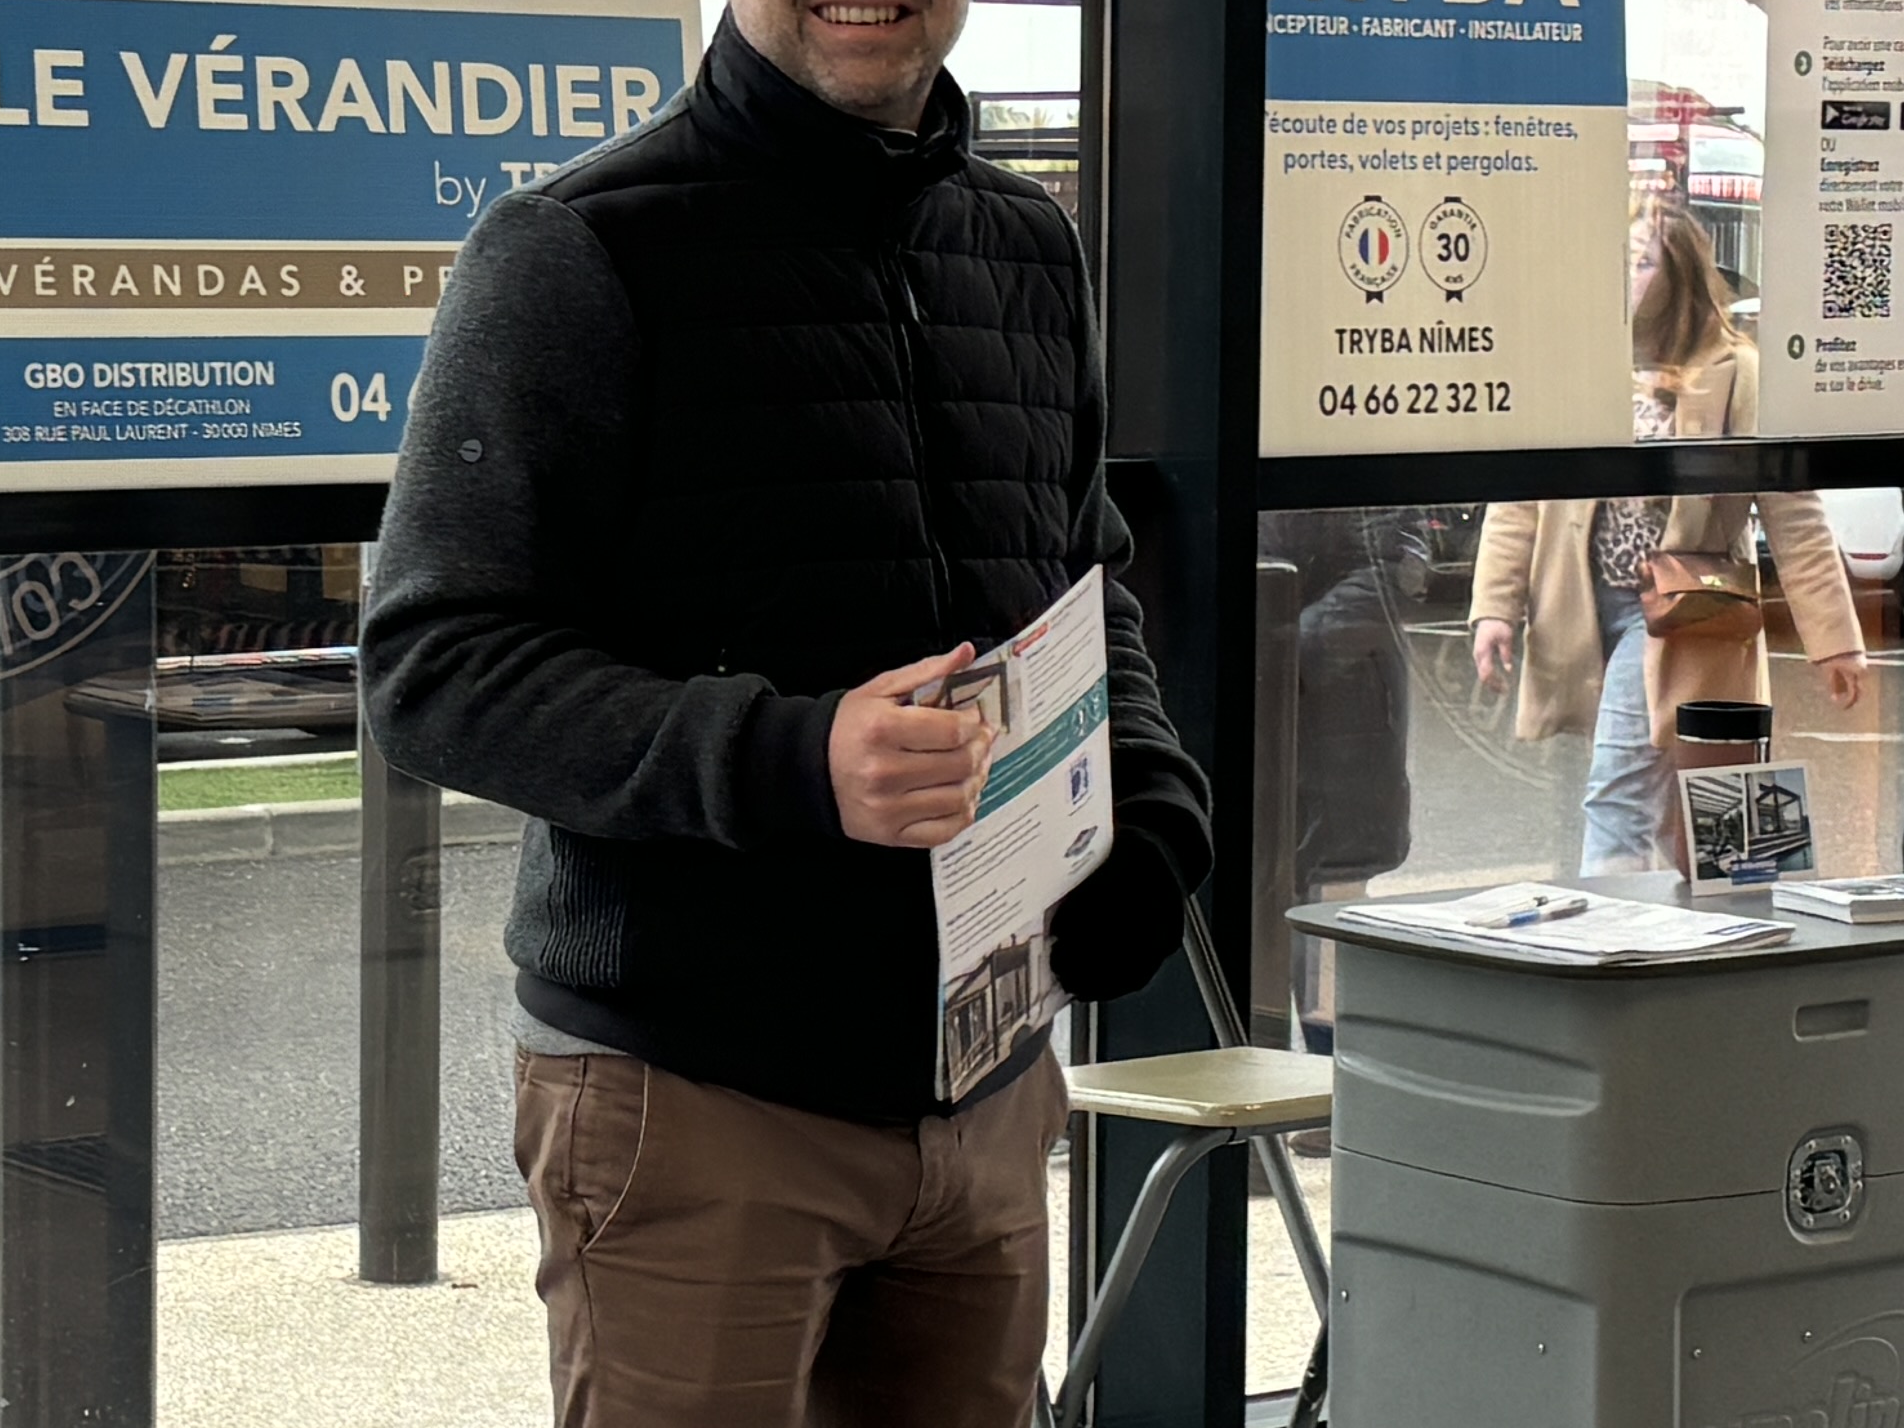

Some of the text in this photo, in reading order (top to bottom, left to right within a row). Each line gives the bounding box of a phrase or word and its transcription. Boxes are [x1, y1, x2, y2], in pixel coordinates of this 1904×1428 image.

[1361, 16, 1456, 38] FABRICANT
[1468, 19, 1583, 42] INSTALLATEUR
[120, 35, 662, 137] VÉRANDIER
[1342, 112, 1367, 135] de
[1374, 119, 1406, 136] vos
[1411, 114, 1480, 140] projets
[1494, 114, 1578, 141] fenêtres,
[1283, 149, 1538, 175] portes, volets et pergolas.
[434, 160, 486, 218] by
[1437, 233, 1469, 262] 30
[338, 267, 367, 296] &
[1334, 320, 1494, 355] TRYBA NÎMES
[24, 361, 275, 389] GBO DISTRIBUTION
[53, 396, 251, 418] EN FACE DE DÉCATHLON
[330, 371, 392, 423] 04
[1318, 381, 1511, 416] 04 66 22 32 12
[34, 425, 67, 442] RUE
[72, 424, 111, 441] PAUL
[116, 423, 188, 440] LAURENT
